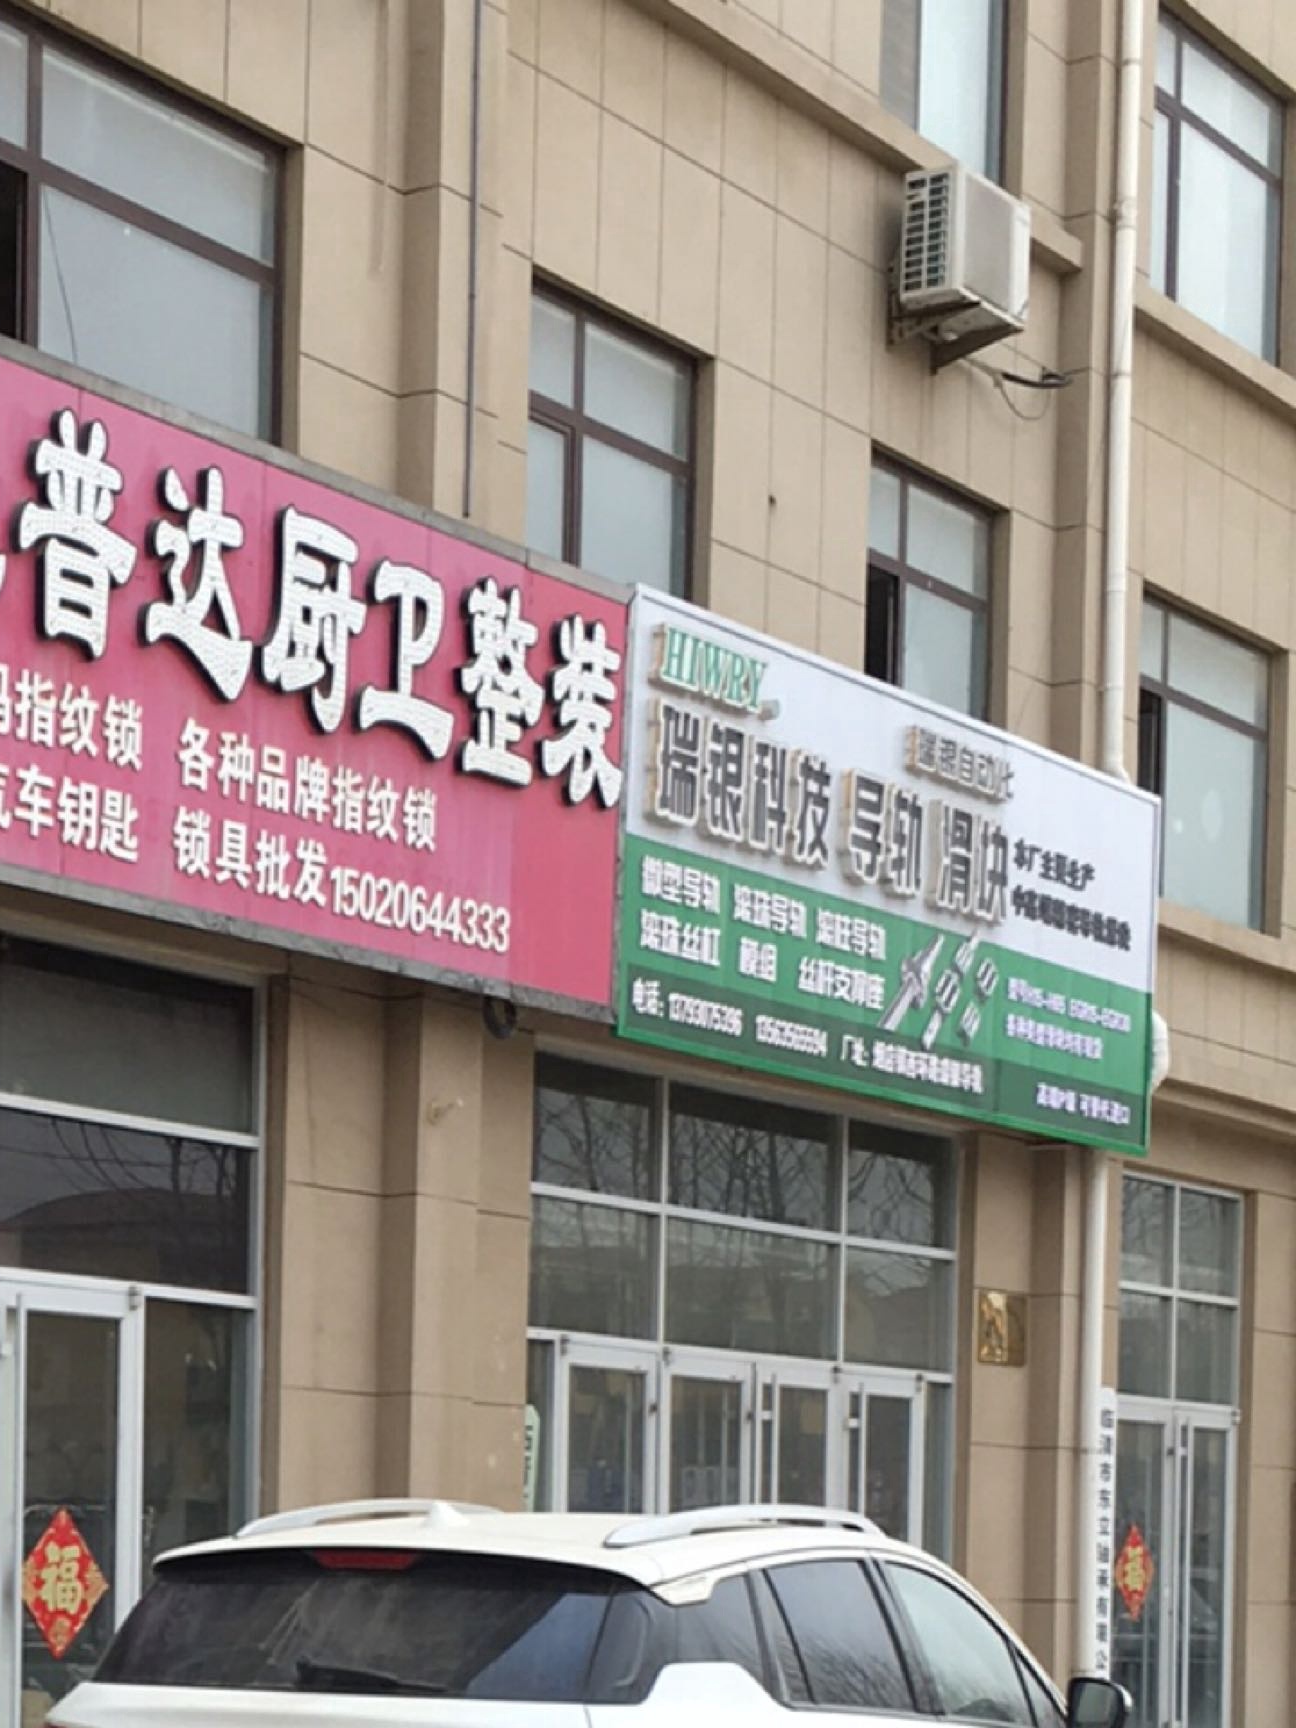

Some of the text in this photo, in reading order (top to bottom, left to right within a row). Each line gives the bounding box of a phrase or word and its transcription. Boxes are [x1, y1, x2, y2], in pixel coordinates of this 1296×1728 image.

[659, 626, 768, 710] HIWRY
[177, 716, 439, 852] 各种品牌指纹锁
[654, 700, 832, 872] 瑞银科技
[846, 770, 924, 900] 导轨
[934, 800, 1010, 923] 滑块
[173, 805, 512, 953] 锁具批发15020644333
[38, 1541, 81, 1615] 福
